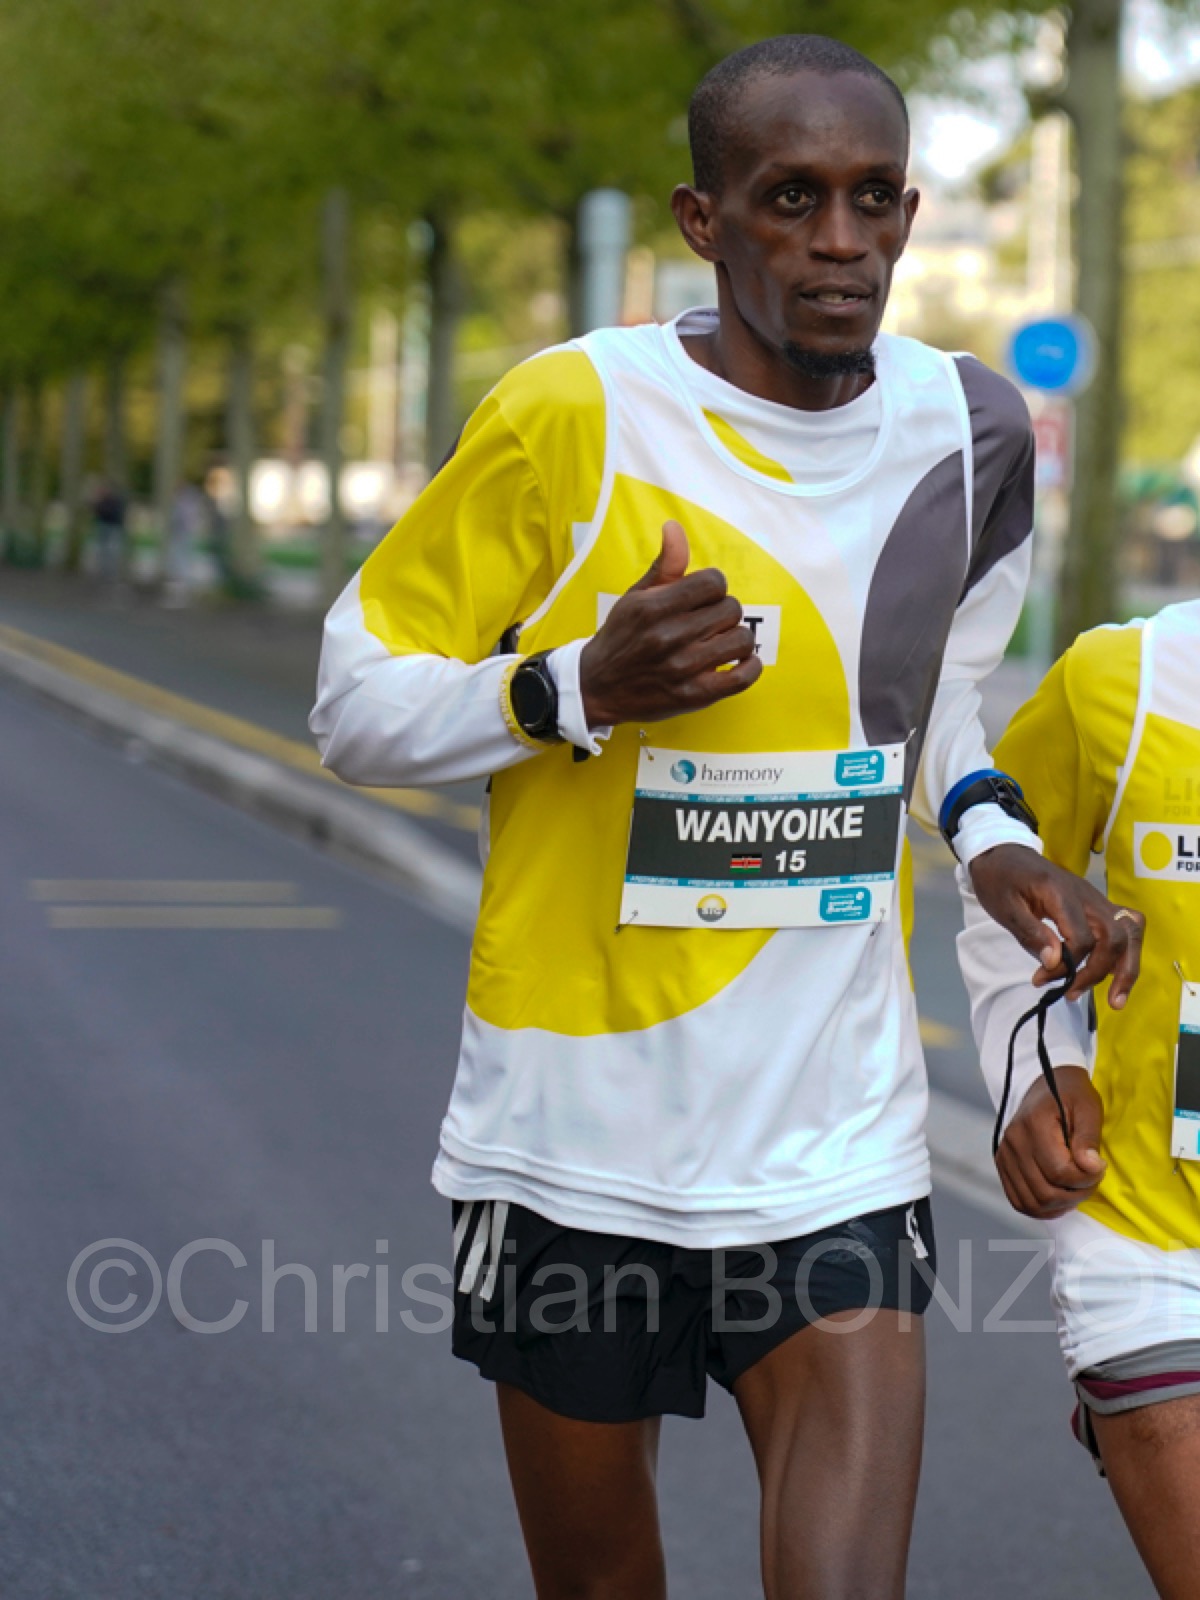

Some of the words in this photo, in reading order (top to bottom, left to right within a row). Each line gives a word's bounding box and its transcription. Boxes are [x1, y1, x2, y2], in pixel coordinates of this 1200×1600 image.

[701, 763, 785, 786] harmony
[675, 806, 865, 843] WANYOIKE
[775, 849, 807, 873] 15
